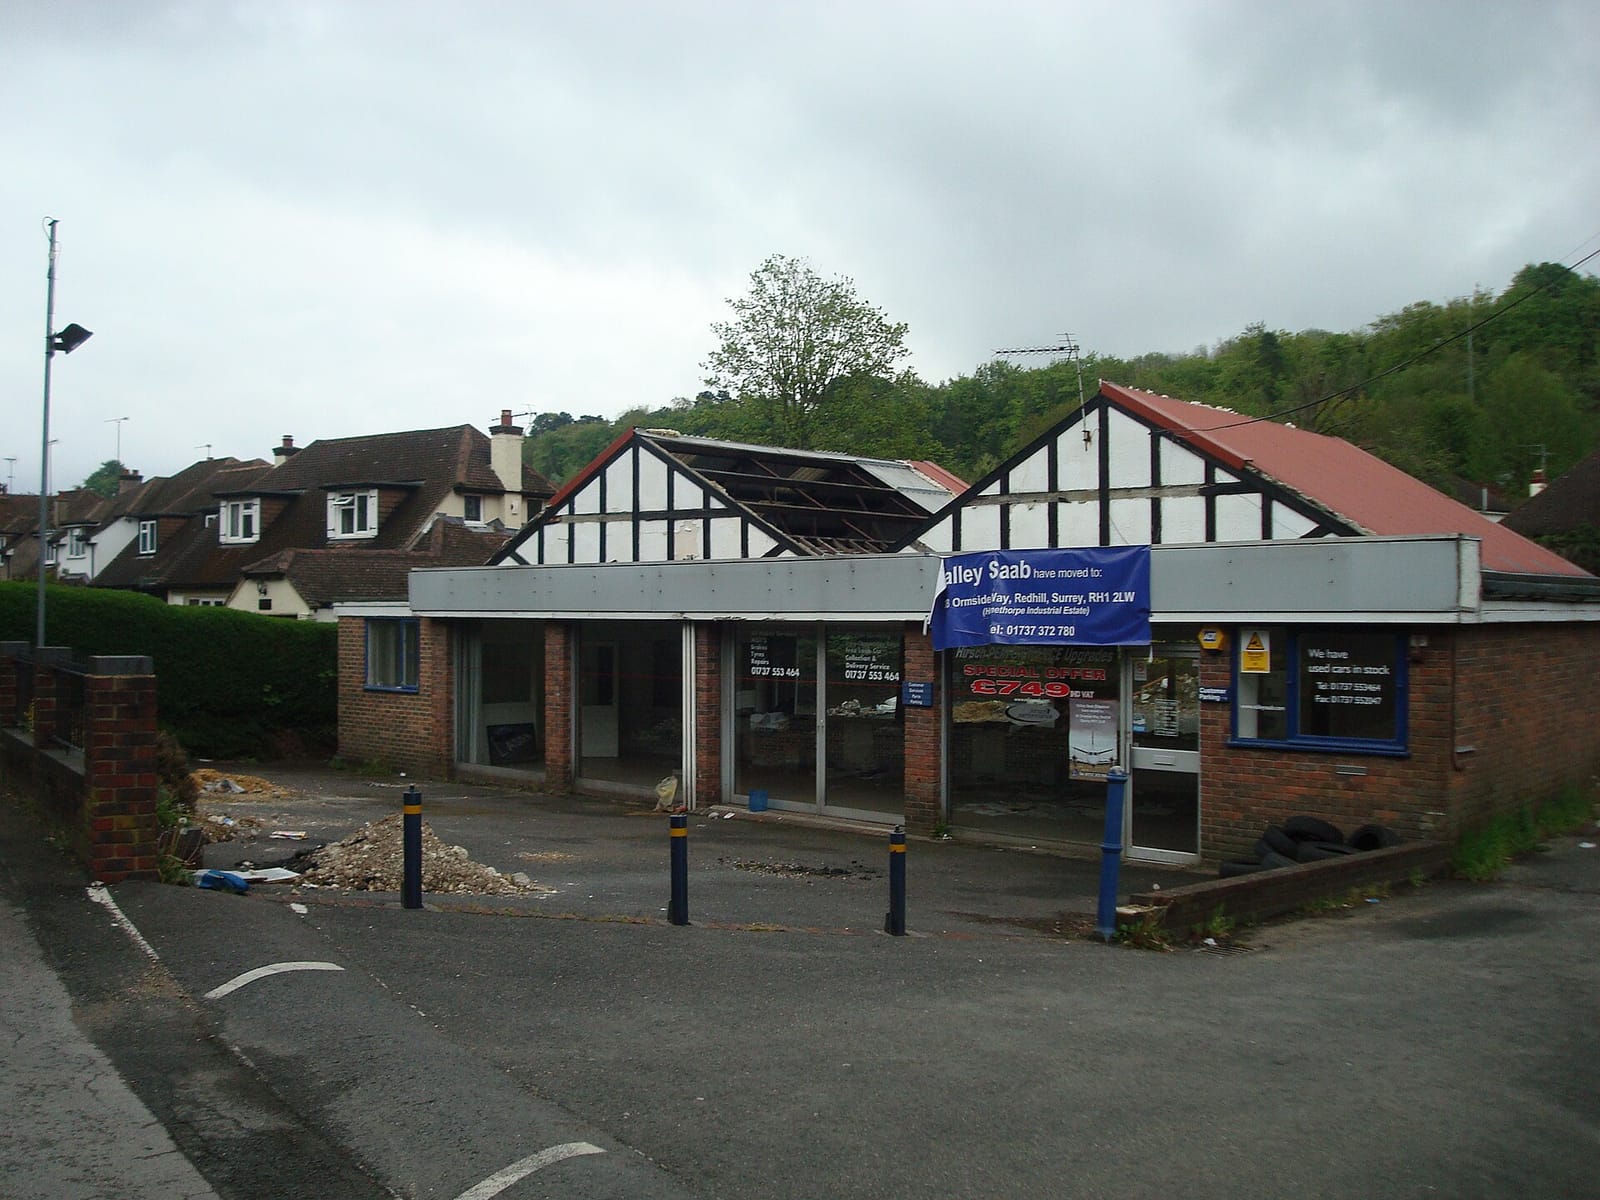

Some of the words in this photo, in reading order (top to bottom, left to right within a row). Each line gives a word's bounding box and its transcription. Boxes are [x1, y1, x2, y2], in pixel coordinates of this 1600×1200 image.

[945, 566, 983, 586] alley
[988, 560, 1031, 579] Saab
[1033, 568, 1056, 579] have
[1058, 567, 1089, 578] moved
[1090, 567, 1103, 578] to:
[1014, 592, 1049, 605] Redhill,
[1051, 592, 1087, 605] Surrey,
[1088, 592, 1110, 603] RH1
[1111, 591, 1136, 603] 2LW
[1026, 606, 1061, 615] Industrial
[1062, 606, 1090, 617] Estate)
[989, 624, 1004, 636] el:
[1006, 625, 1036, 636] 01737
[1038, 625, 1056, 637] 372
[1057, 625, 1076, 637] 780
[1307, 649, 1325, 658] We
[1326, 649, 1349, 659] have
[751, 667, 771, 676] 01737
[772, 667, 785, 677] 553
[786, 668, 800, 677] 464
[845, 662, 869, 671] Delivery
[1308, 663, 1330, 673] used
[1331, 666, 1351, 674] cars
[1352, 664, 1362, 674] in
[1363, 664, 1390, 675] stock
[845, 670, 867, 679] 01737
[868, 671, 883, 680] 553
[884, 671, 900, 681] 464
[963, 664, 1041, 679] SPECIAL
[1045, 666, 1106, 681] OFFER
[970, 678, 1071, 698] £749
[1081, 690, 1095, 699] VAT
[1330, 682, 1353, 691] 01737
[1199, 693, 1221, 702] Parking
[1330, 695, 1353, 704] 01737
